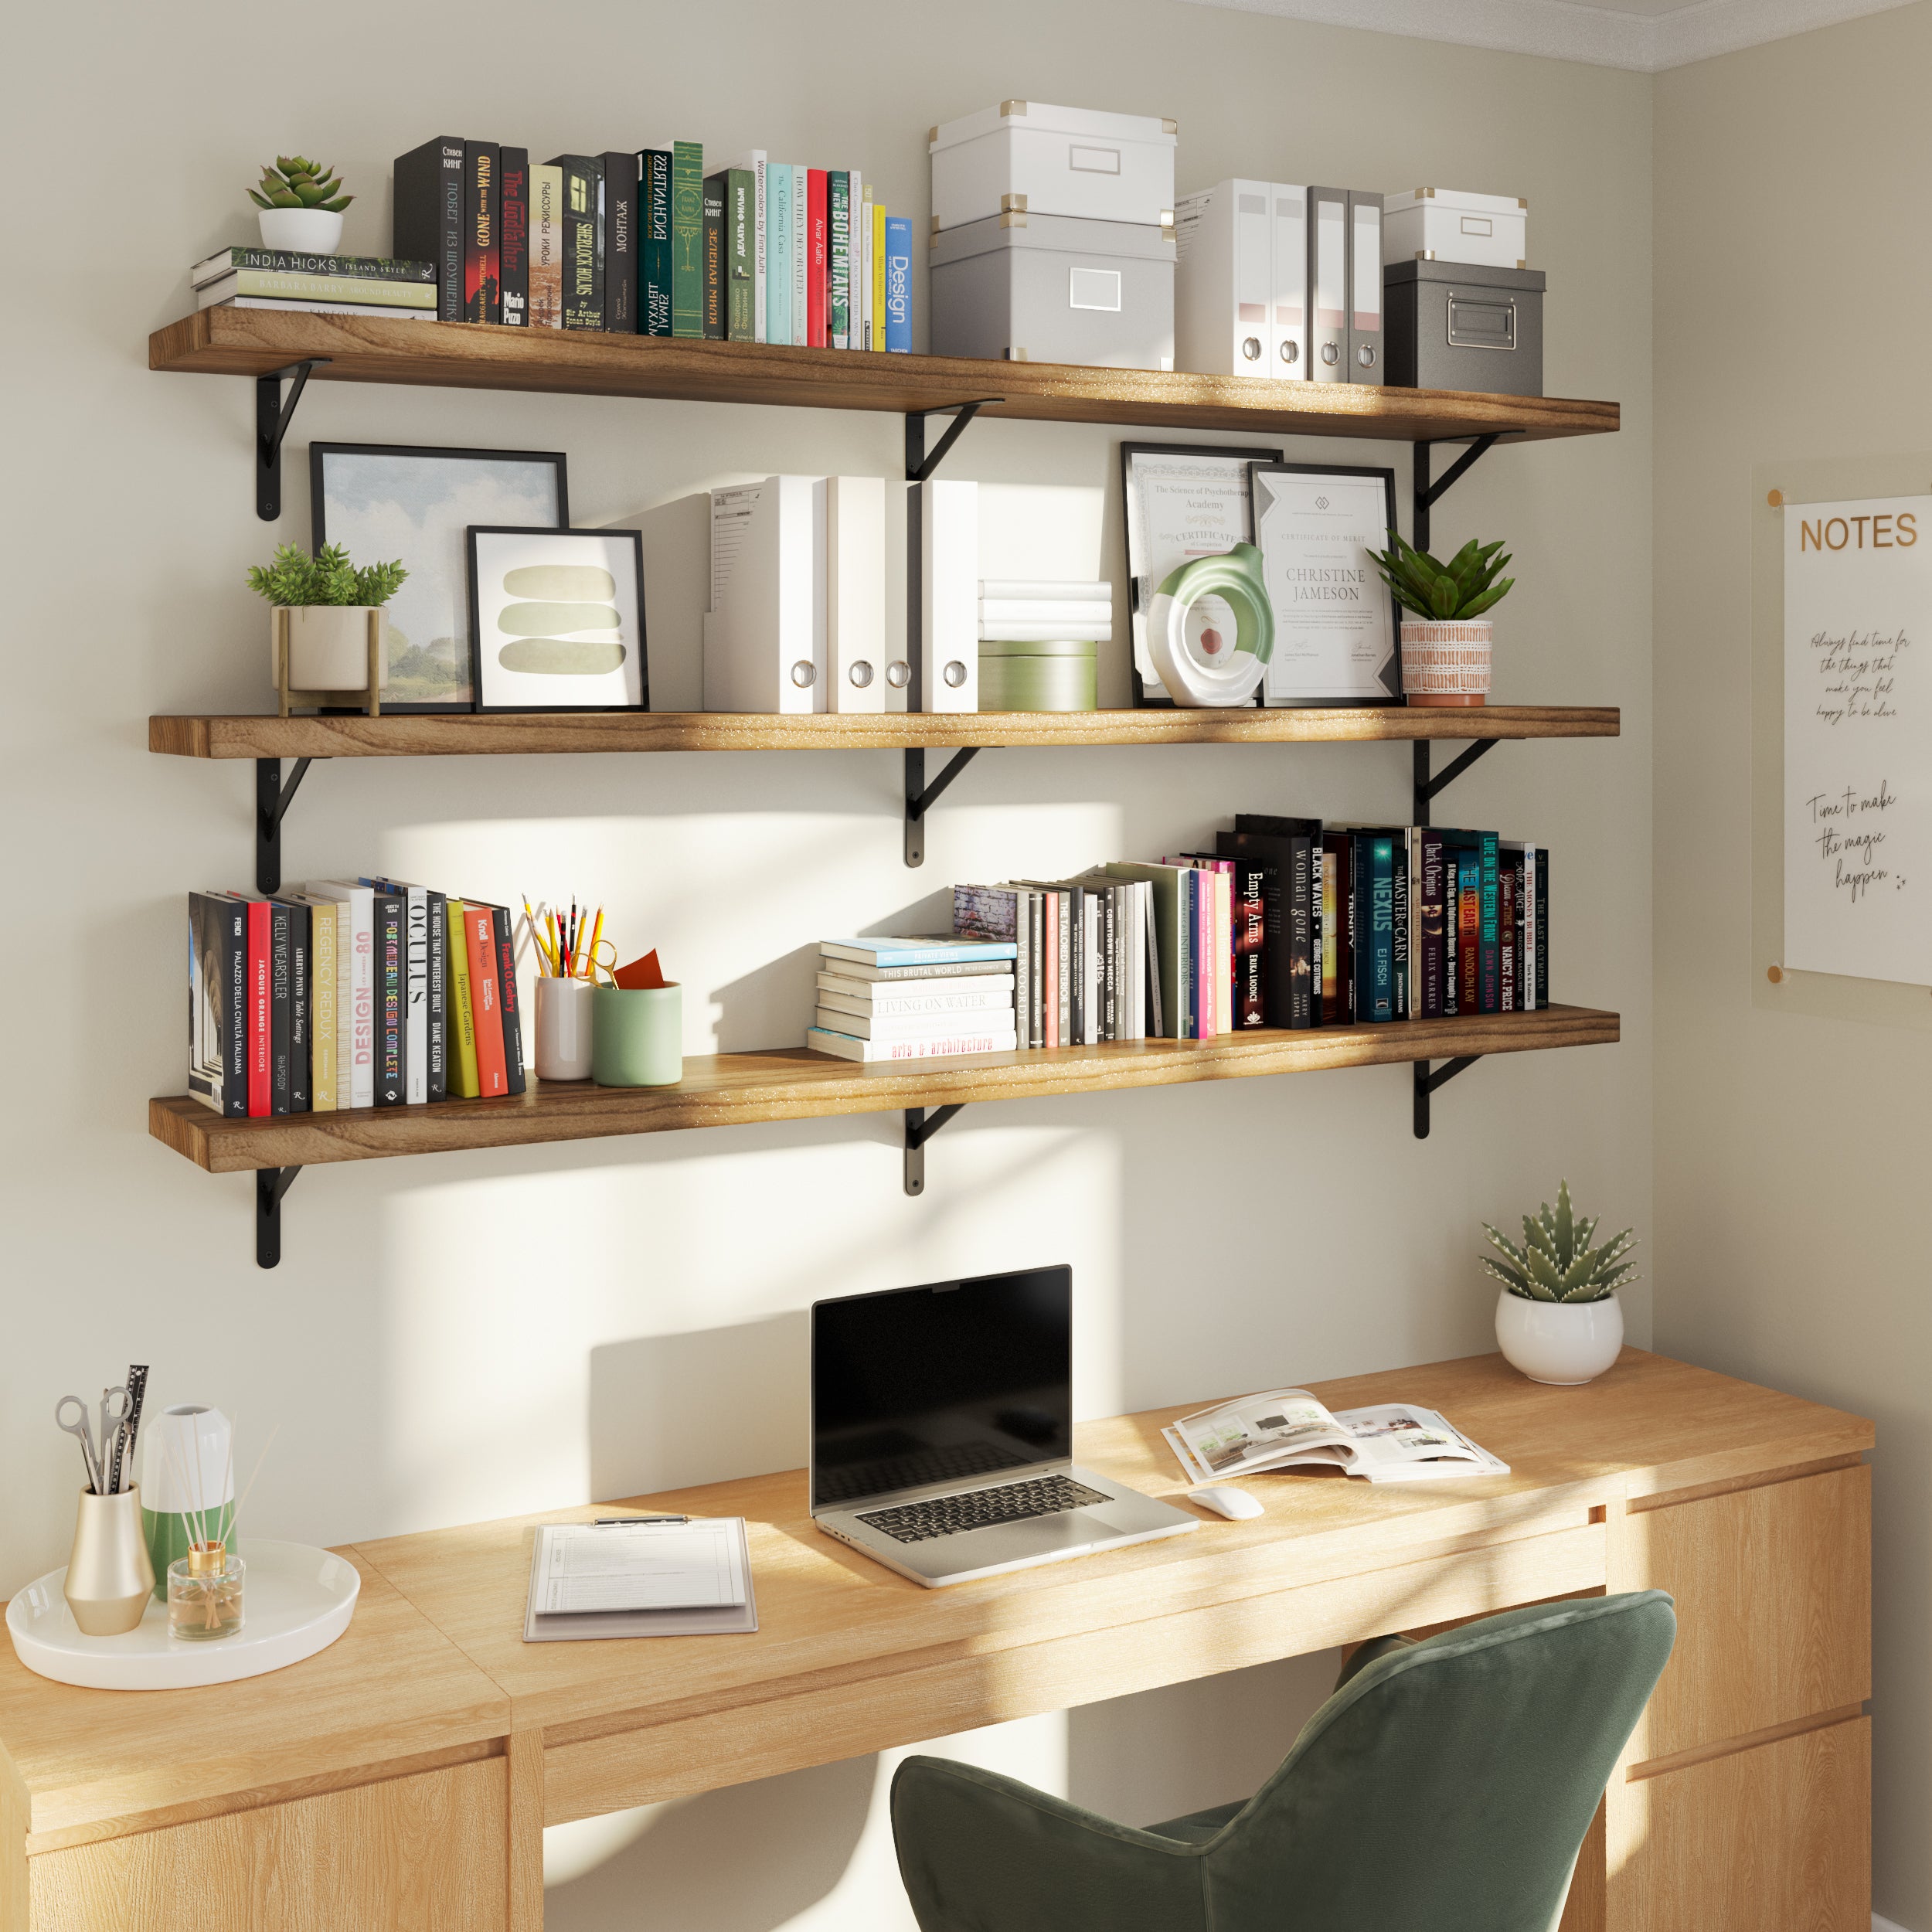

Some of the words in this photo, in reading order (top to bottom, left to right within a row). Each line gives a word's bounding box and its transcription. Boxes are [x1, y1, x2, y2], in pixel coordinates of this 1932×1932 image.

[443, 146, 462, 158] Стивен
[444, 158, 462, 169] КИНГ
[478, 155, 492, 188] WIND
[504, 170, 522, 197] The
[447, 182, 458, 224] ПОБЕГ
[542, 182, 551, 235] РЕЖИССУРЫ
[704, 198, 722, 208] Стивен
[705, 208, 722, 217] КИНГ
[447, 230, 457, 247] ИЗ
[477, 213, 490, 247] GONE
[504, 200, 525, 272] Godfather
[617, 200, 628, 253] МОНТАЖ
[737, 221, 747, 257] ДЕЛАТЬ
[757, 221, 765, 230] by
[542, 238, 550, 267] УРОКИ
[577, 223, 594, 266] SHERLOCK
[709, 227, 718, 285] ЗЕЛЕНАЯ
[245, 253, 286, 267] INDIA
[291, 257, 337, 271] HICKS
[345, 264, 377, 272] ISLAND
[833, 212, 849, 308] BOHEMIANS
[504, 291, 525, 309] Mario
[888, 257, 909, 325] Design
[504, 309, 521, 325] Puzo
[709, 289, 718, 325] МИЛЯ
[1155, 485, 1168, 494] The
[1170, 486, 1195, 495] Science
[1205, 487, 1250, 498] Psychotherap
[1185, 499, 1224, 512] Academy
[1175, 530, 1236, 543] CERTIFICATE
[1801, 513, 1917, 552] NOTES
[1286, 567, 1366, 583] CHRISTINE
[1293, 586, 1360, 603] JAMESON
[1811, 632, 1845, 655] Always
[1849, 631, 1867, 652] find
[1871, 631, 1893, 648] time
[1895, 629, 1910, 652] for
[1820, 657, 1836, 674] the
[1839, 657, 1868, 682] things
[1872, 655, 1896, 671] that
[1825, 680, 1849, 693] make
[1849, 683, 1872, 702] you
[1873, 678, 1893, 699] feel
[1816, 704, 1844, 725] happy
[1848, 703, 1859, 716] to
[1861, 702, 1871, 716] be
[1873, 709, 1896, 717] alive
[1806, 794, 1842, 823] Time
[1842, 785, 1856, 818] to
[1861, 780, 1896, 811] make
[1425, 842, 1442, 865] Dark
[1484, 837, 1497, 856] LOVE
[1815, 828, 1842, 859] the
[1845, 832, 1886, 866] magic
[1312, 847, 1322, 883] BLACK
[1463, 862, 1477, 883] THE
[1484, 856, 1495, 867] ON
[1484, 869, 1495, 883] THE
[1243, 872, 1263, 909] Empty
[1295, 850, 1306, 903] woman
[1425, 865, 1442, 896] Origins
[1836, 859, 1887, 903] happen
[1312, 883, 1322, 918] WAVES
[1372, 877, 1393, 932] NEXUS
[1395, 876, 1406, 920] MASTER
[1463, 886, 1477, 906] LAST
[1484, 884, 1497, 918] WESTERN
[275, 916, 287, 947] KELLY
[478, 919, 488, 940] Knoll
[1249, 913, 1263, 944] Arms
[1291, 909, 1306, 943] gone
[1463, 907, 1477, 937] EARTH
[1484, 920, 1497, 943] FRONT
[320, 917, 332, 988] REGENCY
[355, 930, 372, 954] 80
[386, 921, 398, 988] POSTMODERN
[408, 905, 427, 1004] OCULUS
[478, 941, 487, 968] Design
[1377, 947, 1387, 958] EJ
[1394, 927, 1406, 961] CARN
[502, 943, 512, 972] Frank
[883, 969, 903, 978] THIS
[903, 968, 932, 977] BRUTAL
[935, 966, 961, 975] WORLD
[1249, 954, 1258, 974] ERIKA
[1502, 946, 1513, 976] NANCY
[275, 949, 287, 999] WEARSTLER
[505, 972, 512, 984] O.
[1377, 961, 1388, 986] FISCH
[457, 974, 468, 1009] Japanese
[505, 984, 516, 1013] Gehry
[1249, 974, 1257, 1003] LIODICE
[1502, 985, 1513, 1011] PRICE
[295, 1000, 304, 1019] Table
[320, 991, 332, 1040] REDUX
[386, 988, 398, 1026] DESIGN
[878, 997, 921, 1013] LIVING
[925, 998, 943, 1010] ON
[946, 994, 986, 1008] WATER
[235, 1011, 244, 1039] CIVILTÀ
[294, 1019, 303, 1044] Settings
[355, 988, 371, 1065] DESIGN
[386, 1028, 398, 1079] COMPLETE
[892, 1042, 912, 1058] arts
[920, 1043, 925, 1056] &
[930, 1037, 992, 1055] architecture
[277, 1055, 286, 1091] RHAPSODY
